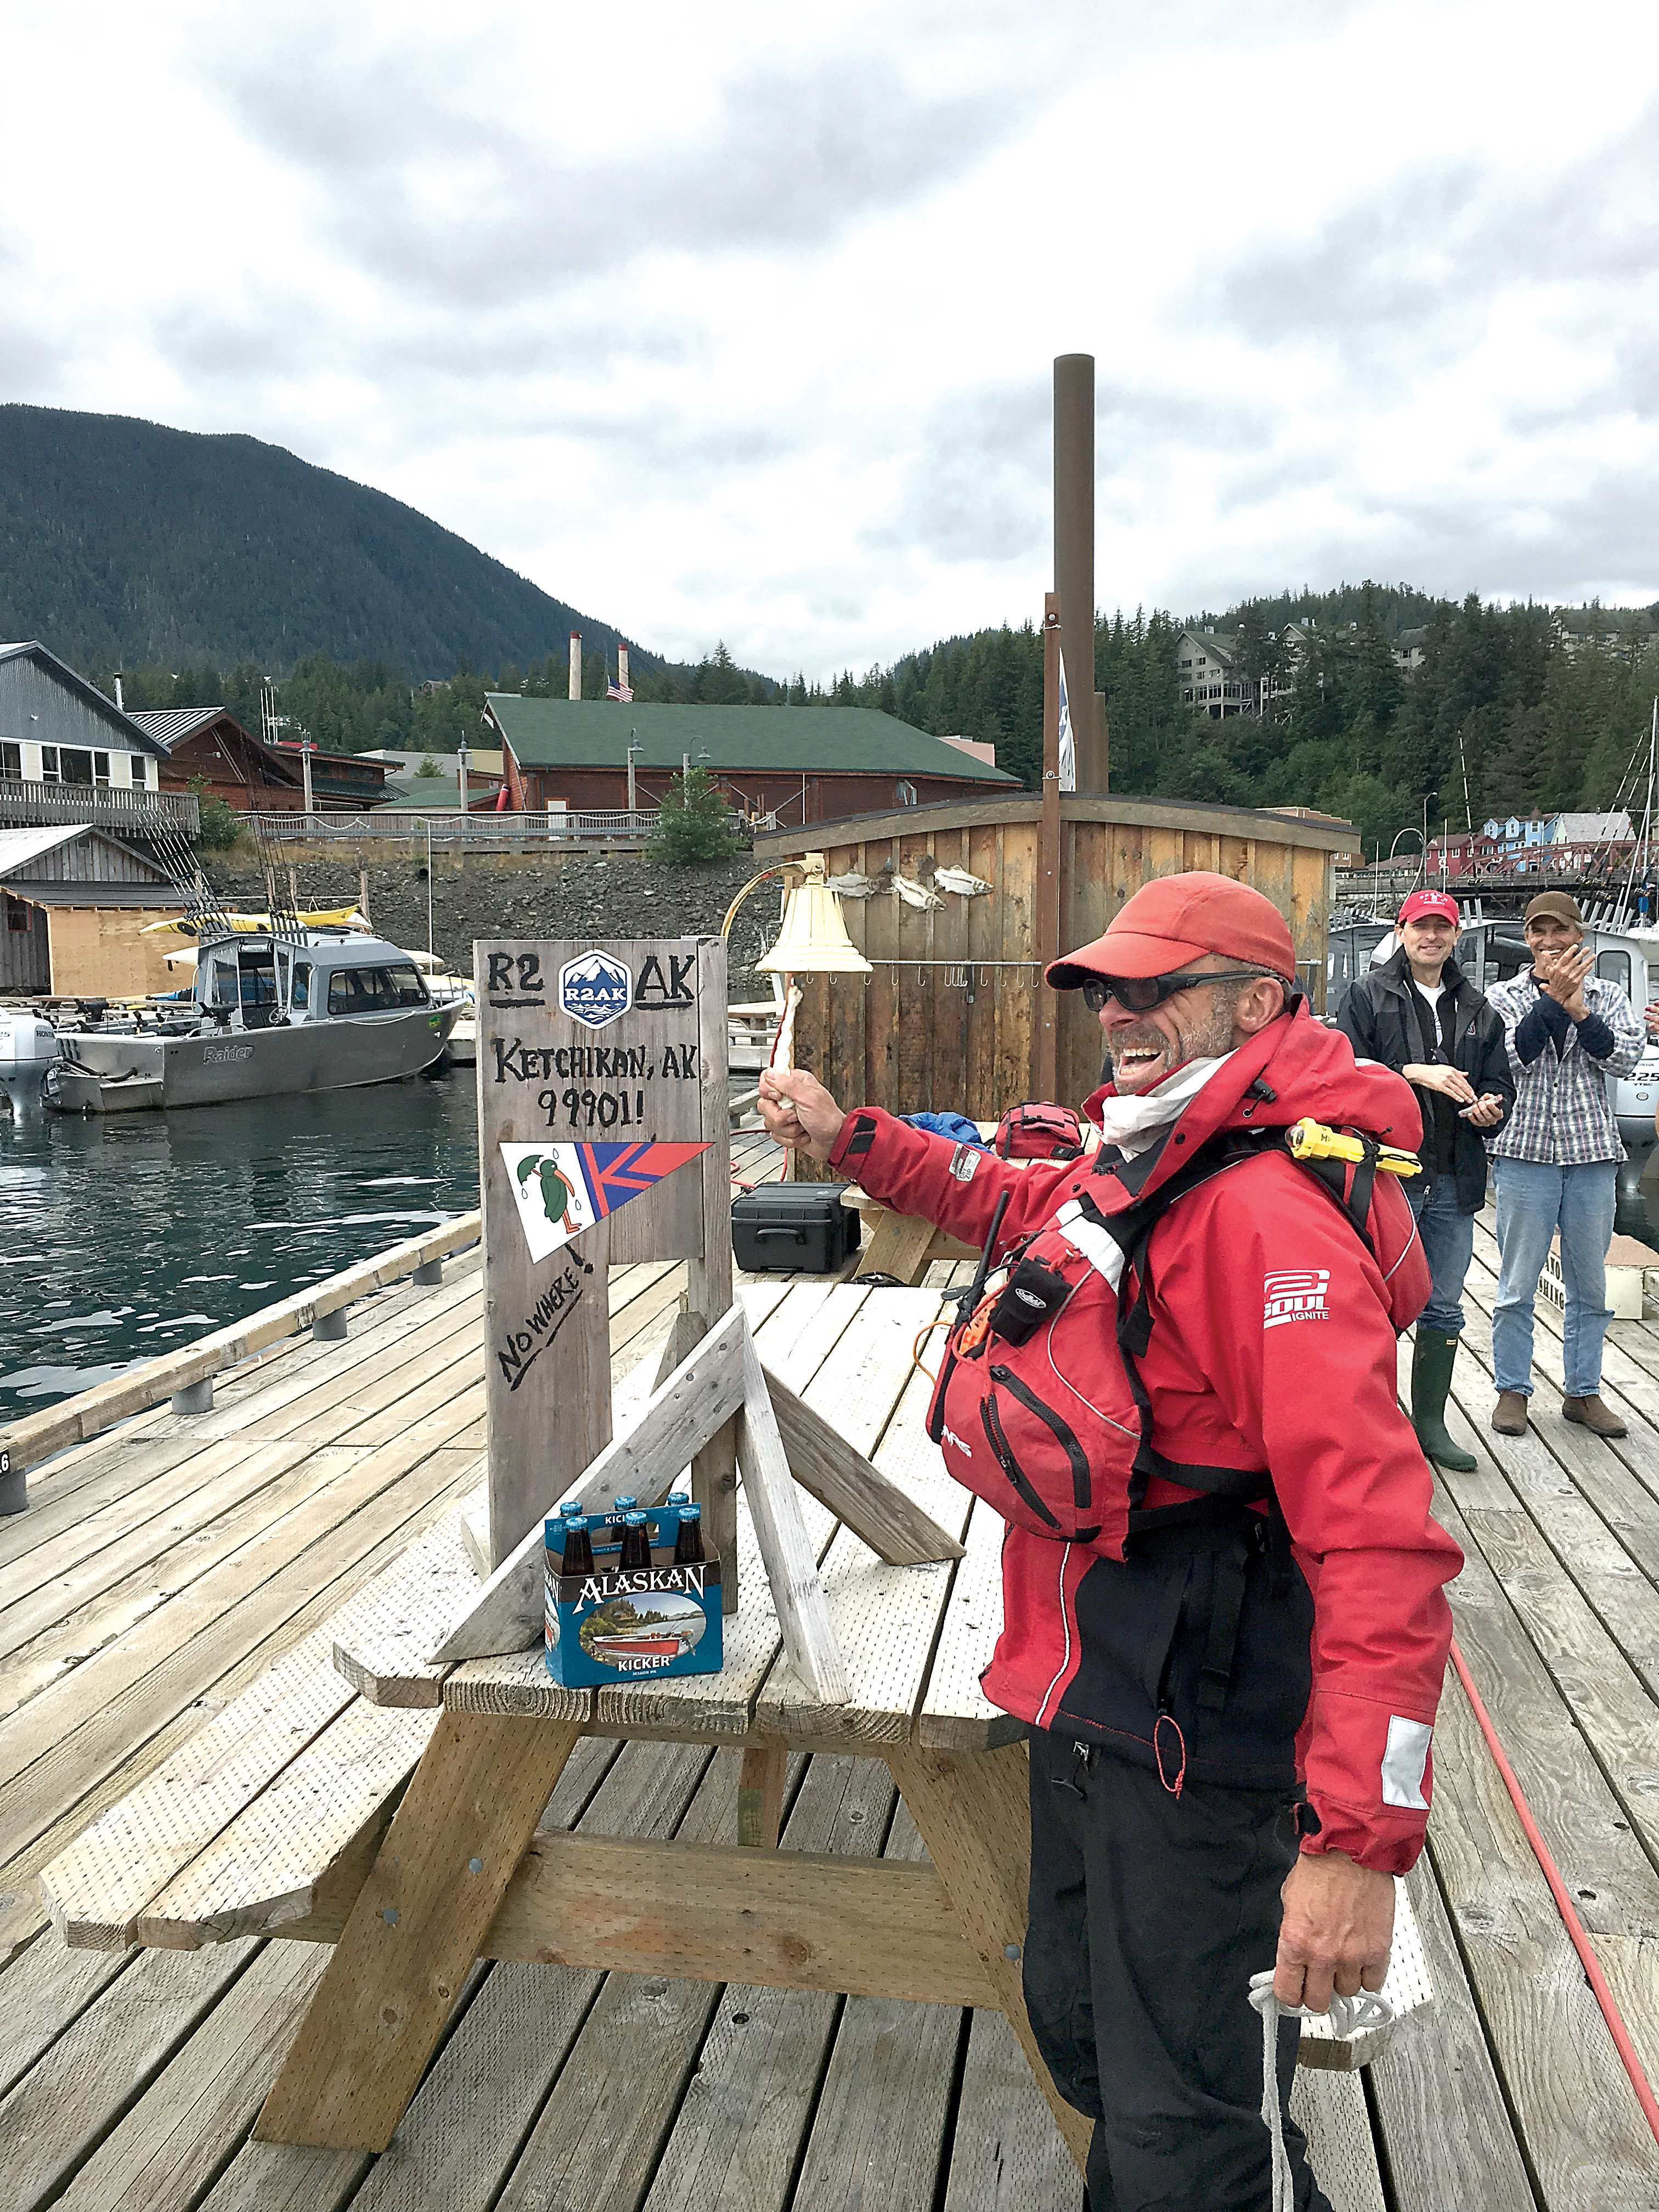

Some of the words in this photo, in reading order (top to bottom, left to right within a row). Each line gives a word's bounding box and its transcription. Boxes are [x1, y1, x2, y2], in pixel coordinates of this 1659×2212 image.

[487, 952, 545, 991] R2
[635, 955, 695, 1001] AK
[565, 988, 627, 1001] R2AK
[203, 1045, 253, 1065] Raider
[490, 1037, 654, 1084] KETCHIKAN,
[662, 1044, 698, 1081] AK
[1623, 1072, 1659, 1081] 225
[538, 1087, 644, 1127] 99901!
[1537, 1276, 1564, 1310] SHING
[1292, 1311, 1329, 1322] IGNITE
[0, 1454, 9, 1474] 6
[605, 1515, 625, 1524] KIC
[572, 1565, 707, 1615] ALASKAN
[618, 1656, 670, 1672] KICKER
